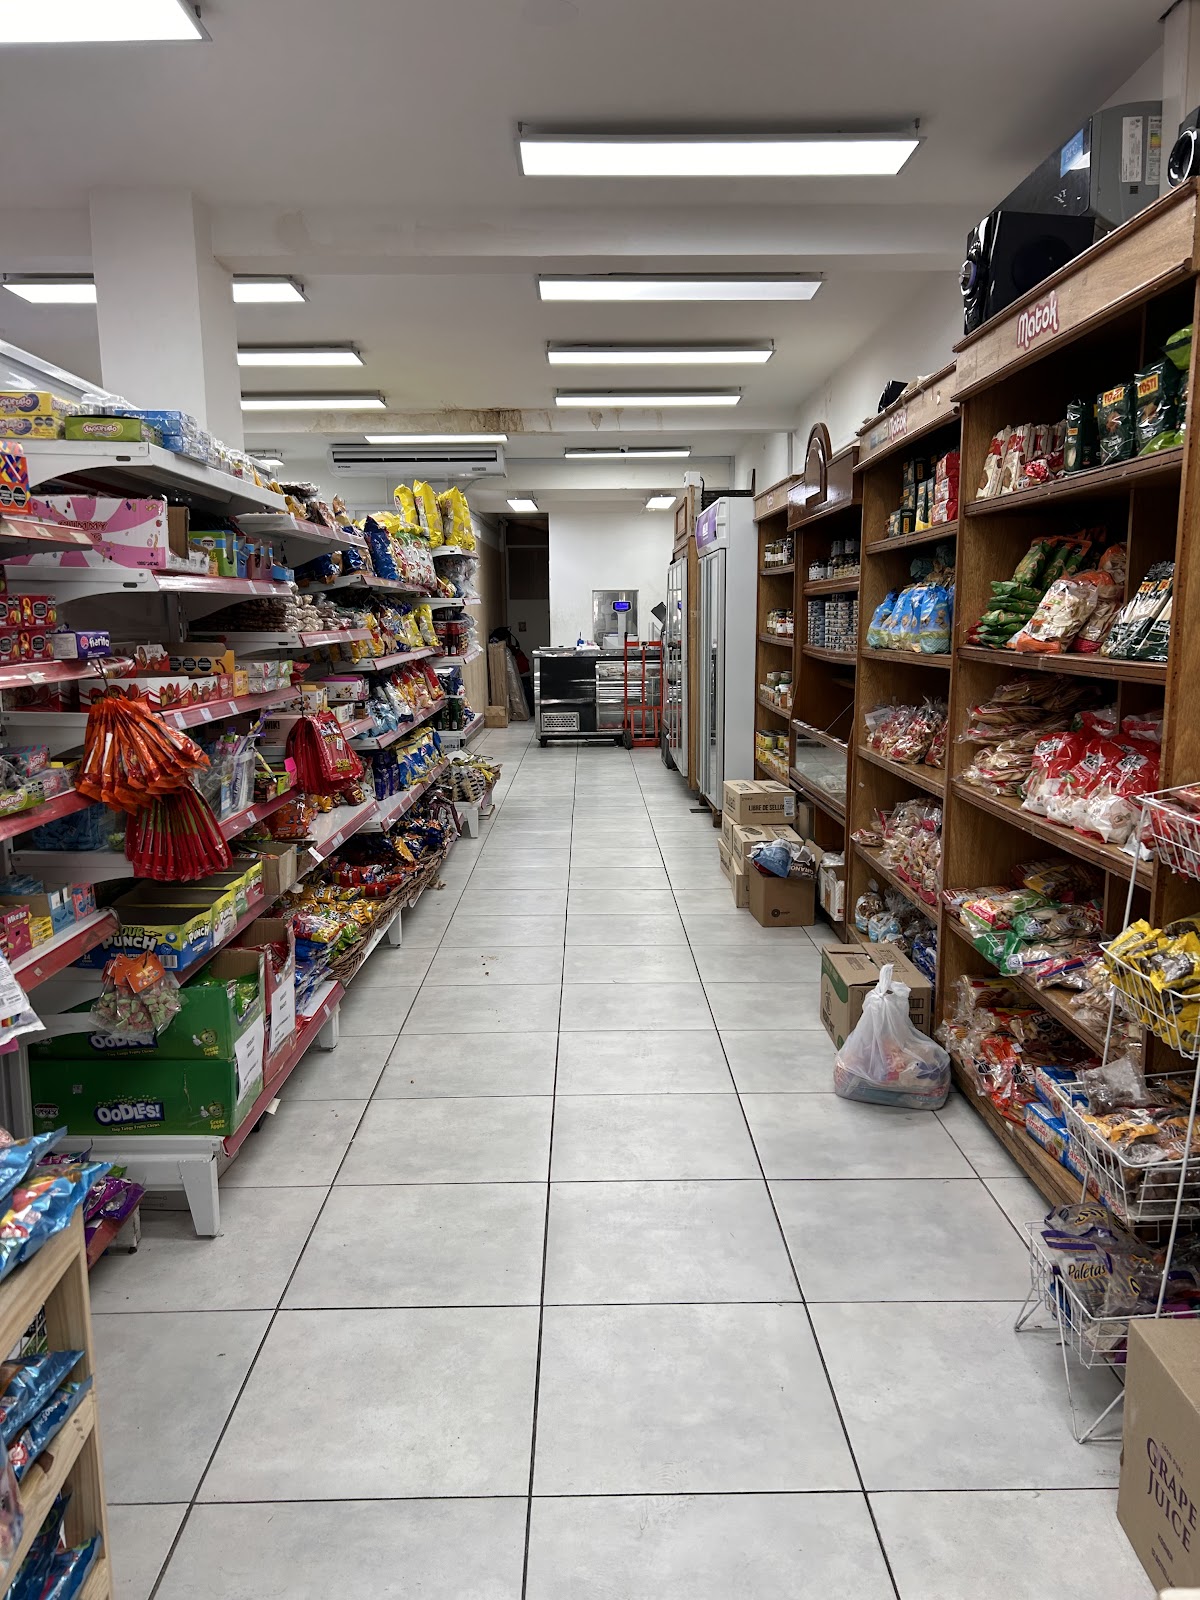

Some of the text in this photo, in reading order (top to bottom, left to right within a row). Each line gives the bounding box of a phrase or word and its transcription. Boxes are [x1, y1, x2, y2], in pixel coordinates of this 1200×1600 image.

[1138, 376, 1158, 394] TOSTI
[102, 936, 157, 951] PUNCH
[188, 925, 210, 944] PUNCH
[1068, 1263, 1106, 1280] Paletas
[1146, 1437, 1198, 1531] GRAPE
[1147, 1466, 1191, 1553] JUICE
